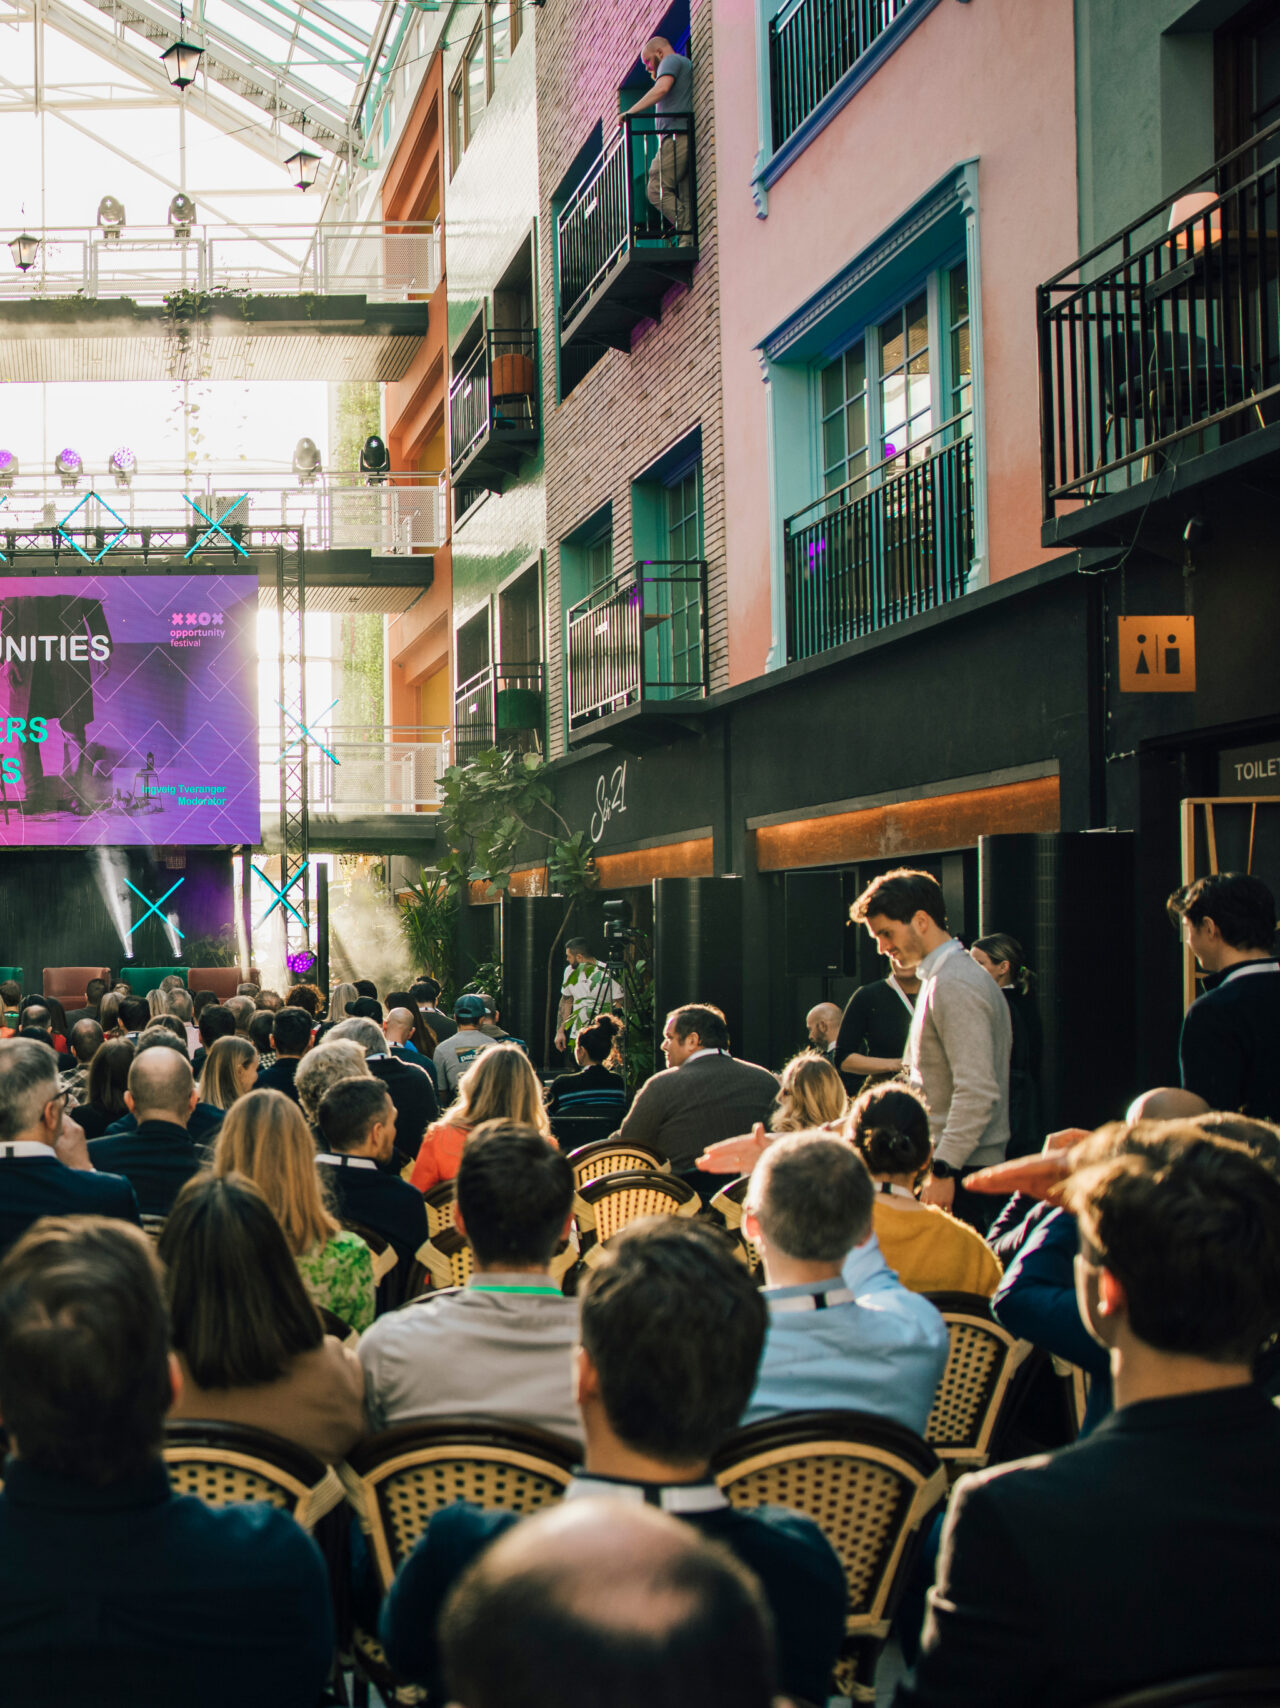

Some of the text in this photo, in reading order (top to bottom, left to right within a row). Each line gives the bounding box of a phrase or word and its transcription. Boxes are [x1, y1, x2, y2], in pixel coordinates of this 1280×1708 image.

[170, 628, 226, 639] opportunity
[170, 638, 201, 647] festival
[178, 796, 227, 806] Moderator
